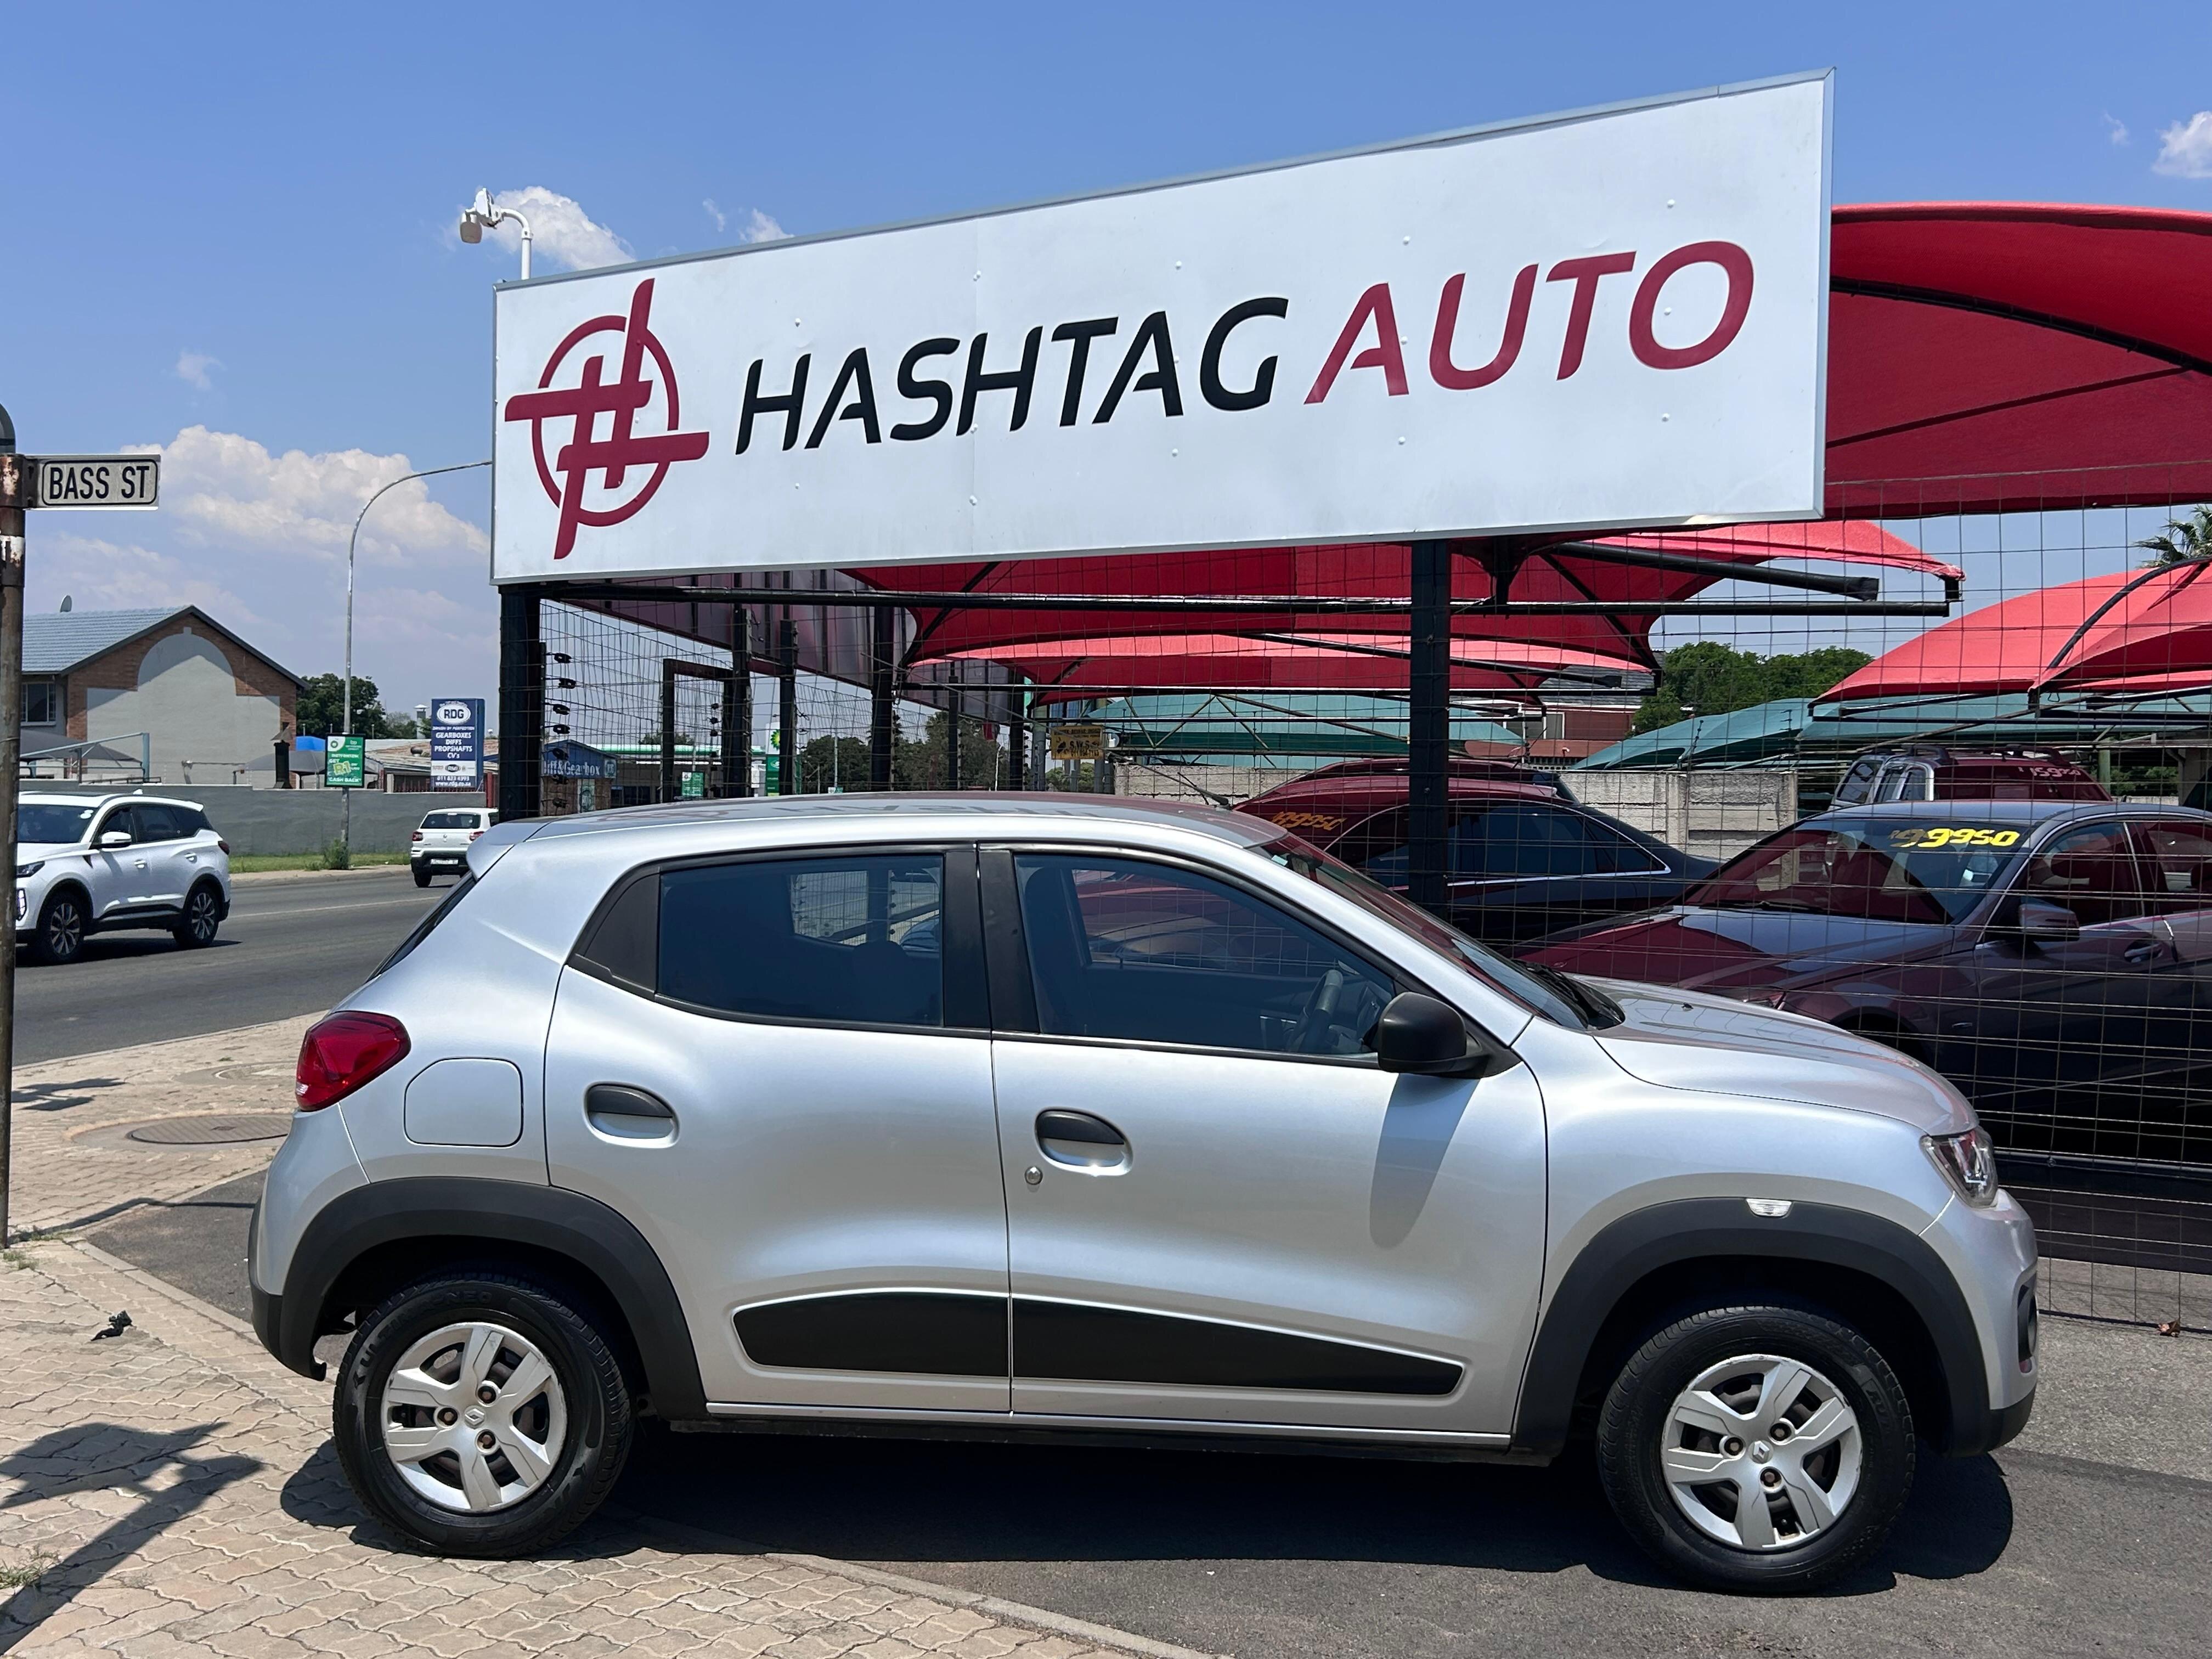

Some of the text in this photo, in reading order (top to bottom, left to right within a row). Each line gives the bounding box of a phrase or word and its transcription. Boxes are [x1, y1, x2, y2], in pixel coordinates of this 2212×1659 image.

[736, 240, 1754, 454] HASHTAG AUTO
[49, 466, 149, 499] BASS ST
[444, 709, 464, 719] RDG
